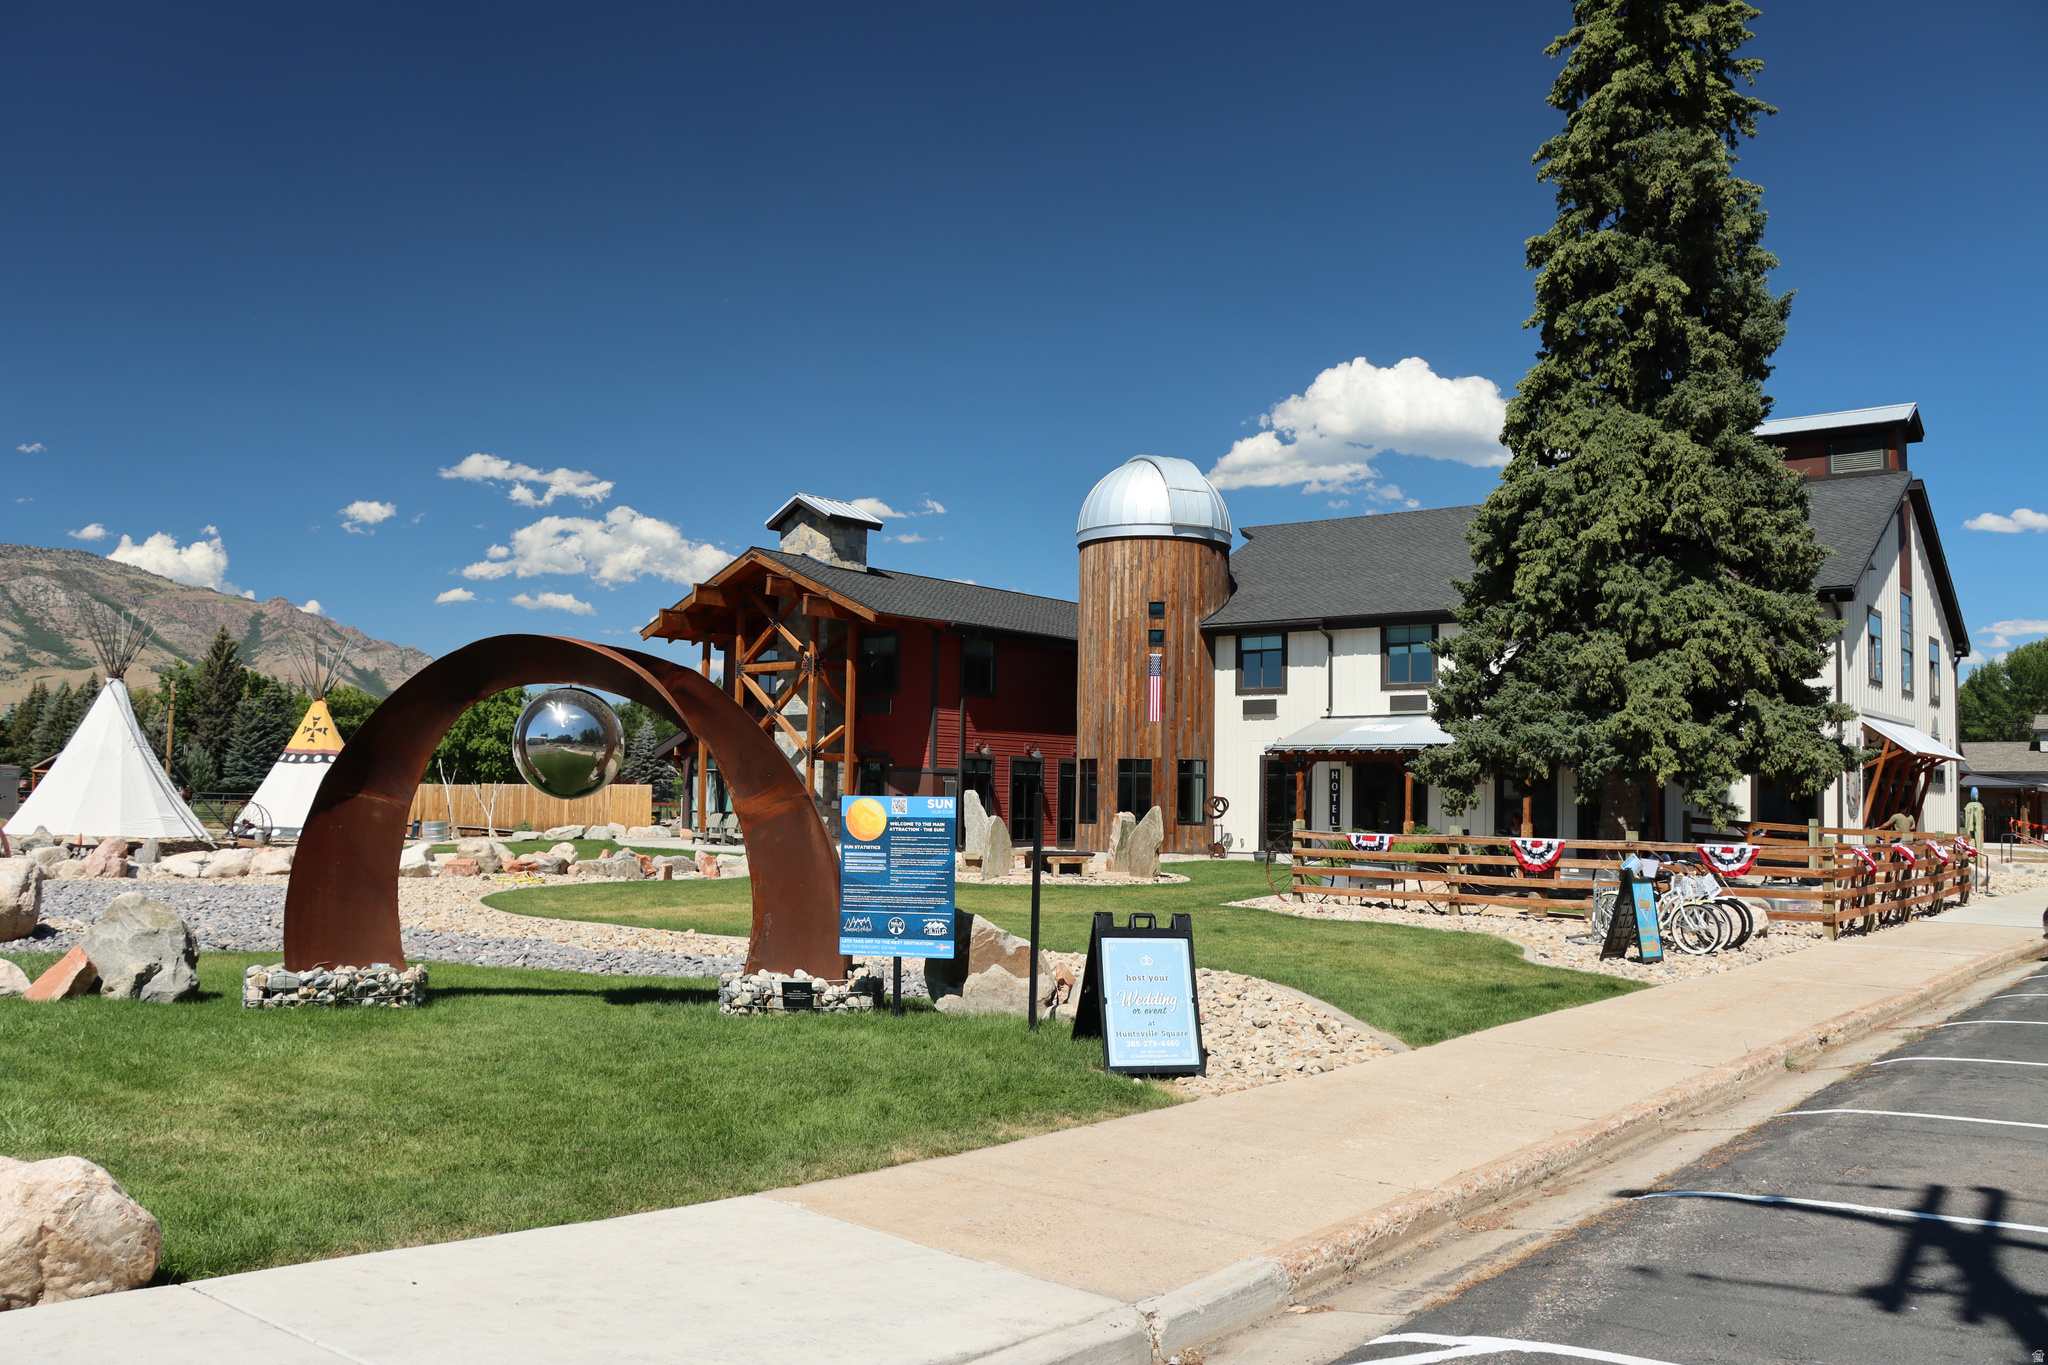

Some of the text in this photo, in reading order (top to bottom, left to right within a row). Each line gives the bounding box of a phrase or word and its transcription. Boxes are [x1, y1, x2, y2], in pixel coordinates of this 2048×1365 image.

[869, 762, 880, 770] 198
[927, 798, 954, 809] SUN
[1116, 989, 1178, 1012] Wedding
